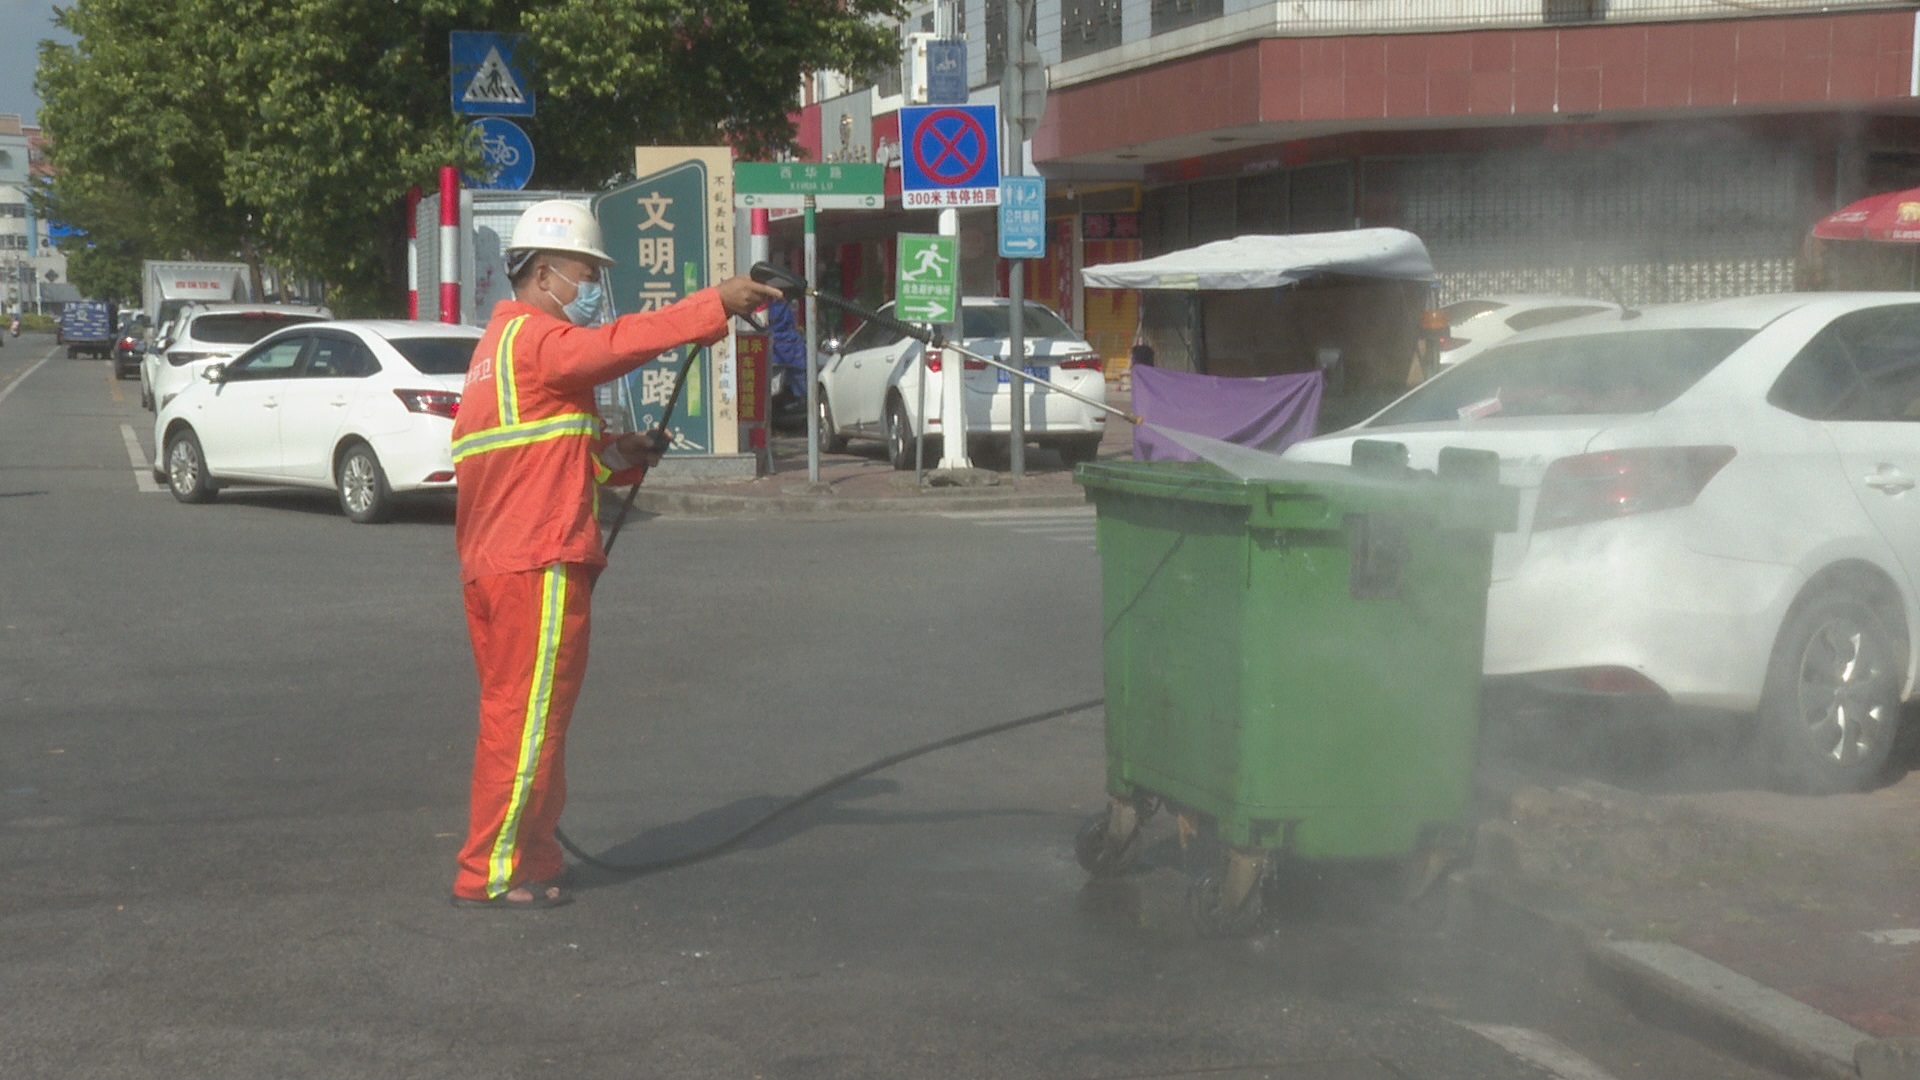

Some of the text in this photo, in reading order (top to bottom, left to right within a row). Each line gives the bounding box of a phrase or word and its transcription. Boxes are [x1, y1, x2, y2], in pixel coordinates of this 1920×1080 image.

[780, 166, 841, 179] 西华路
[907, 189, 997, 205] 300米 违停拍照
